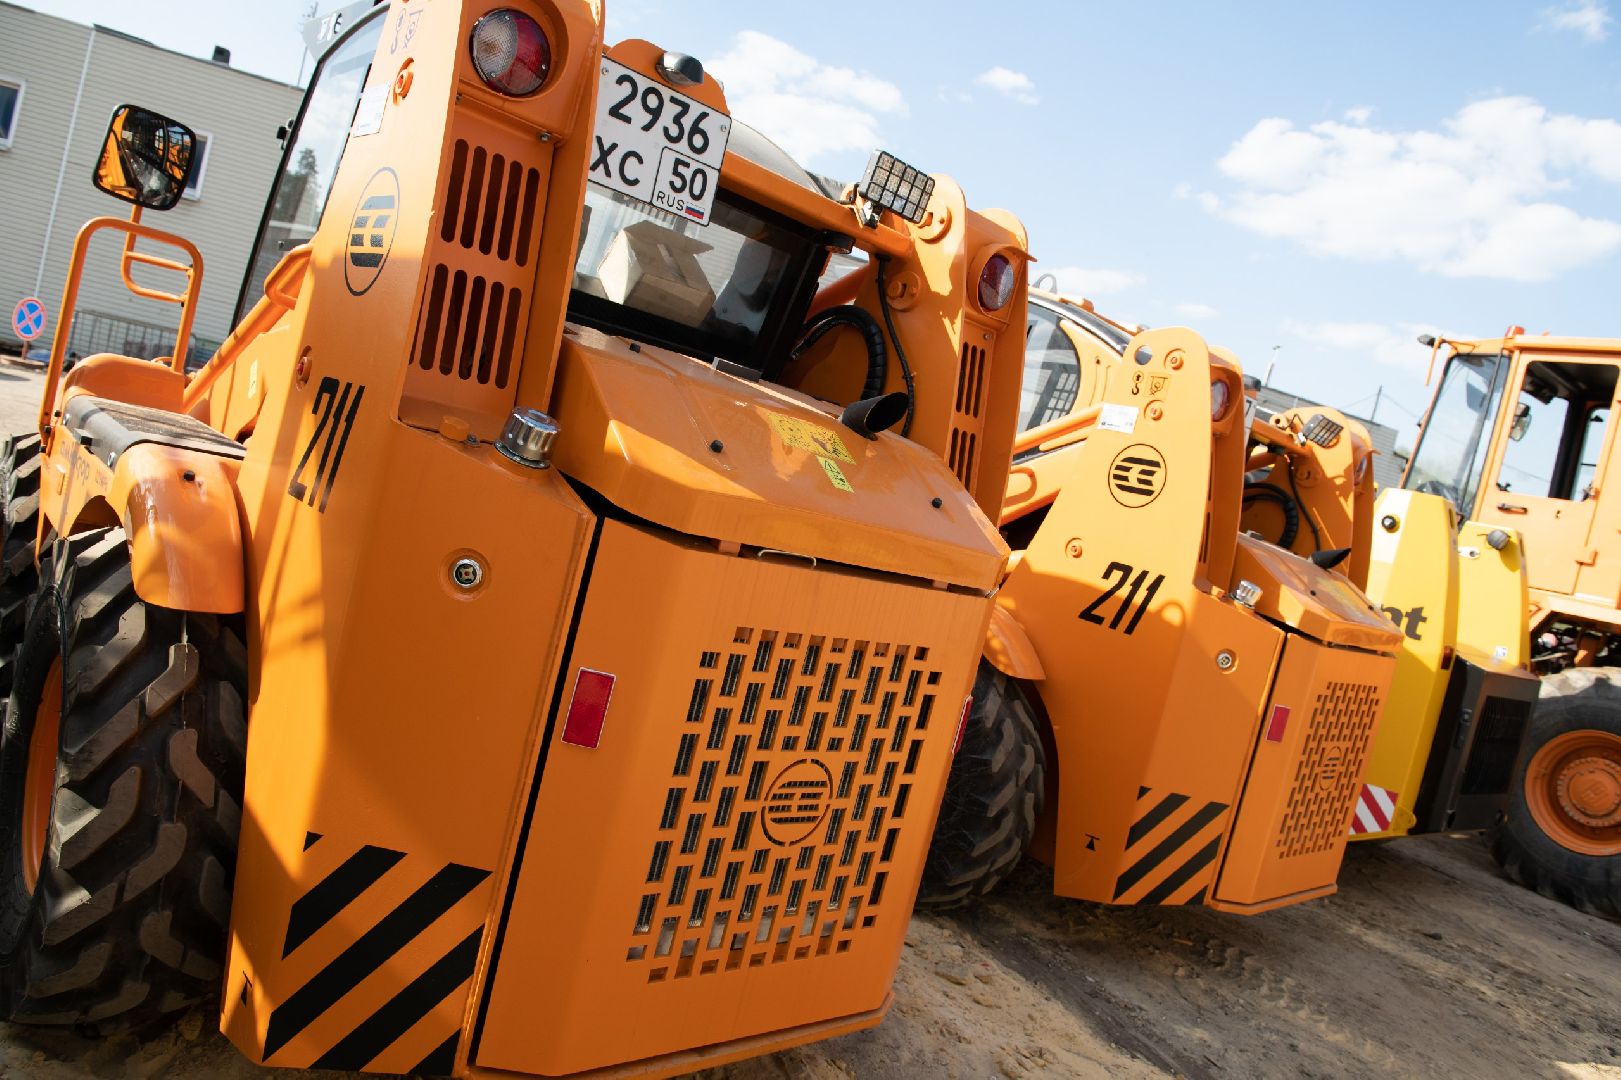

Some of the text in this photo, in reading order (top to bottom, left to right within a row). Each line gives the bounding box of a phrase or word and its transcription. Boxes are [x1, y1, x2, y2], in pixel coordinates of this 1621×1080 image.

[608, 74, 710, 155] 2936
[656, 190, 685, 212] RUS
[669, 157, 708, 202] 50
[287, 376, 366, 514] 211
[1078, 561, 1166, 636] 211
